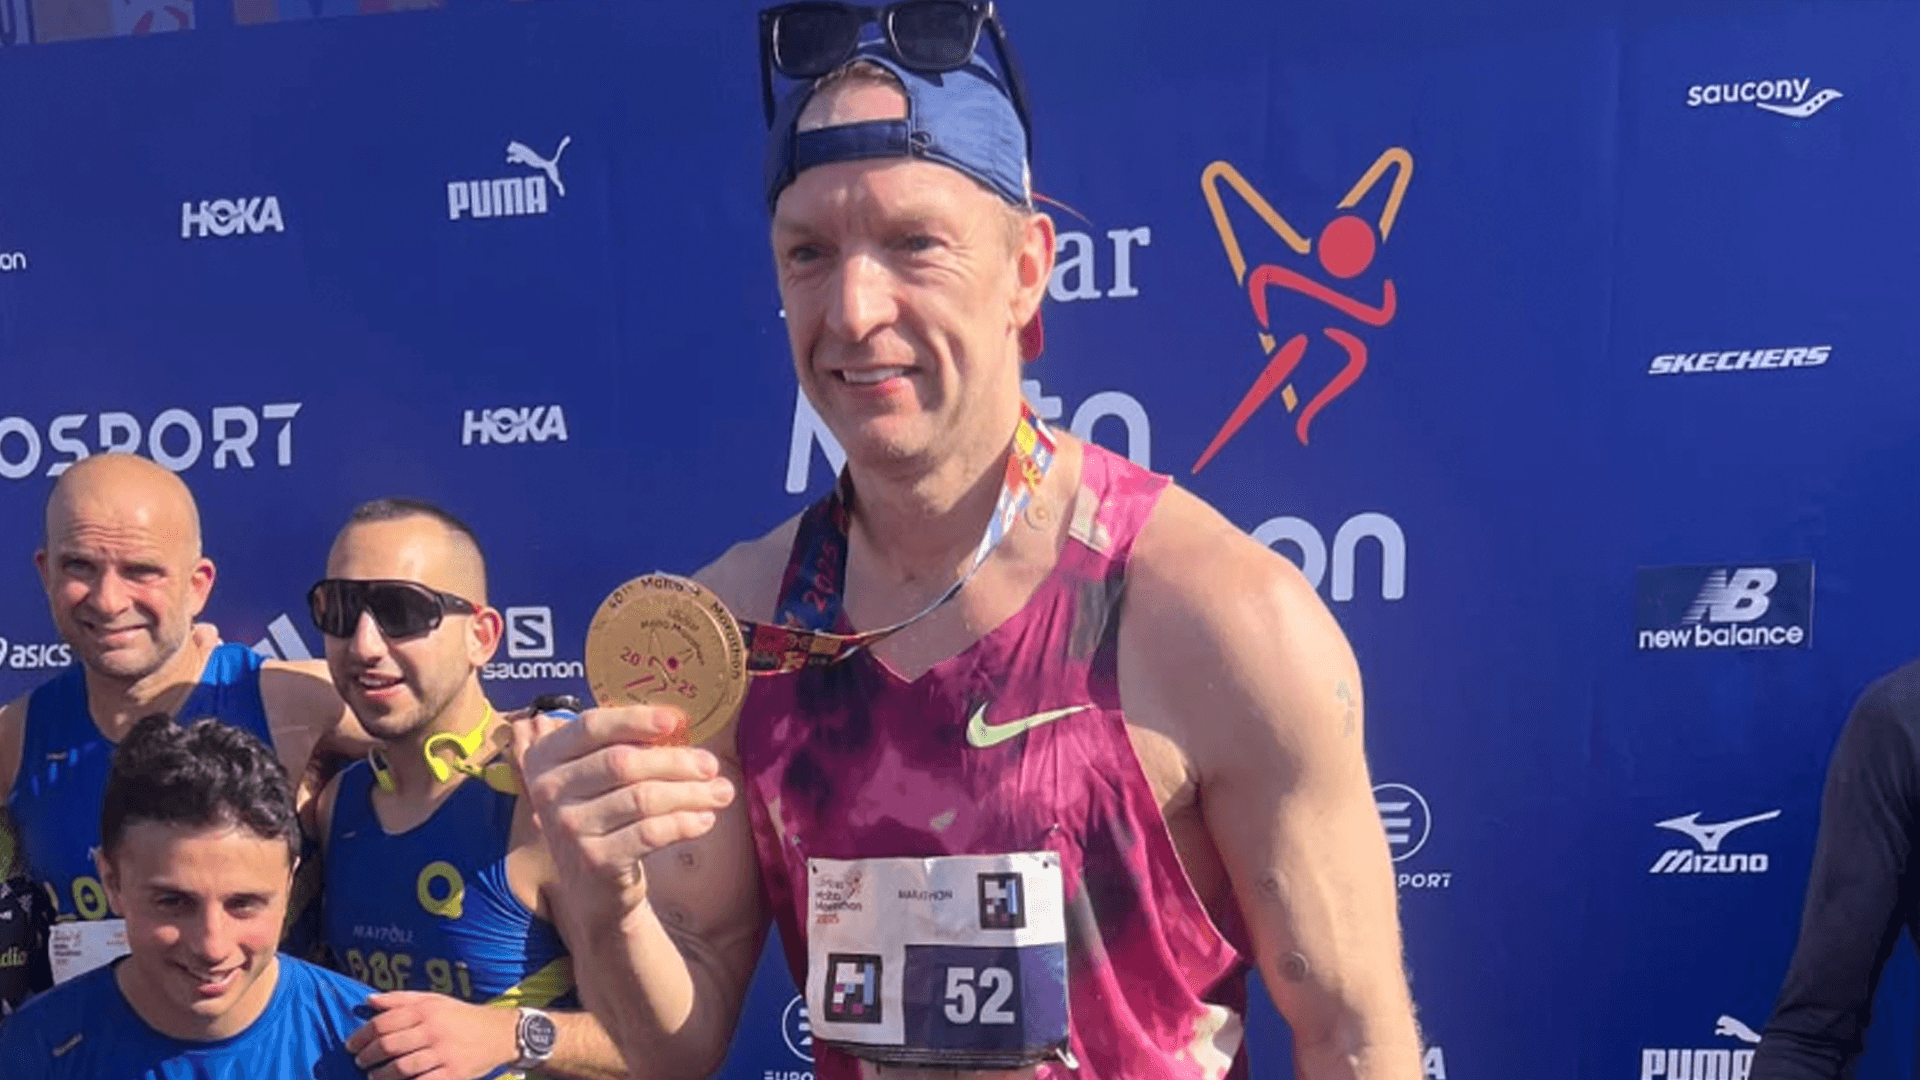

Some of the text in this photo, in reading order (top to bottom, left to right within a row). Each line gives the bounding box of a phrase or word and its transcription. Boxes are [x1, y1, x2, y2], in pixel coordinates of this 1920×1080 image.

[1687, 77, 1811, 107] saucony
[448, 176, 548, 220] PUMA
[181, 196, 285, 238] HOKA
[1648, 345, 1833, 375] SKECHERS
[462, 405, 568, 445] HOKA
[1639, 623, 1804, 649] new balance
[9, 643, 72, 669] asics
[944, 966, 1016, 1024] 52
